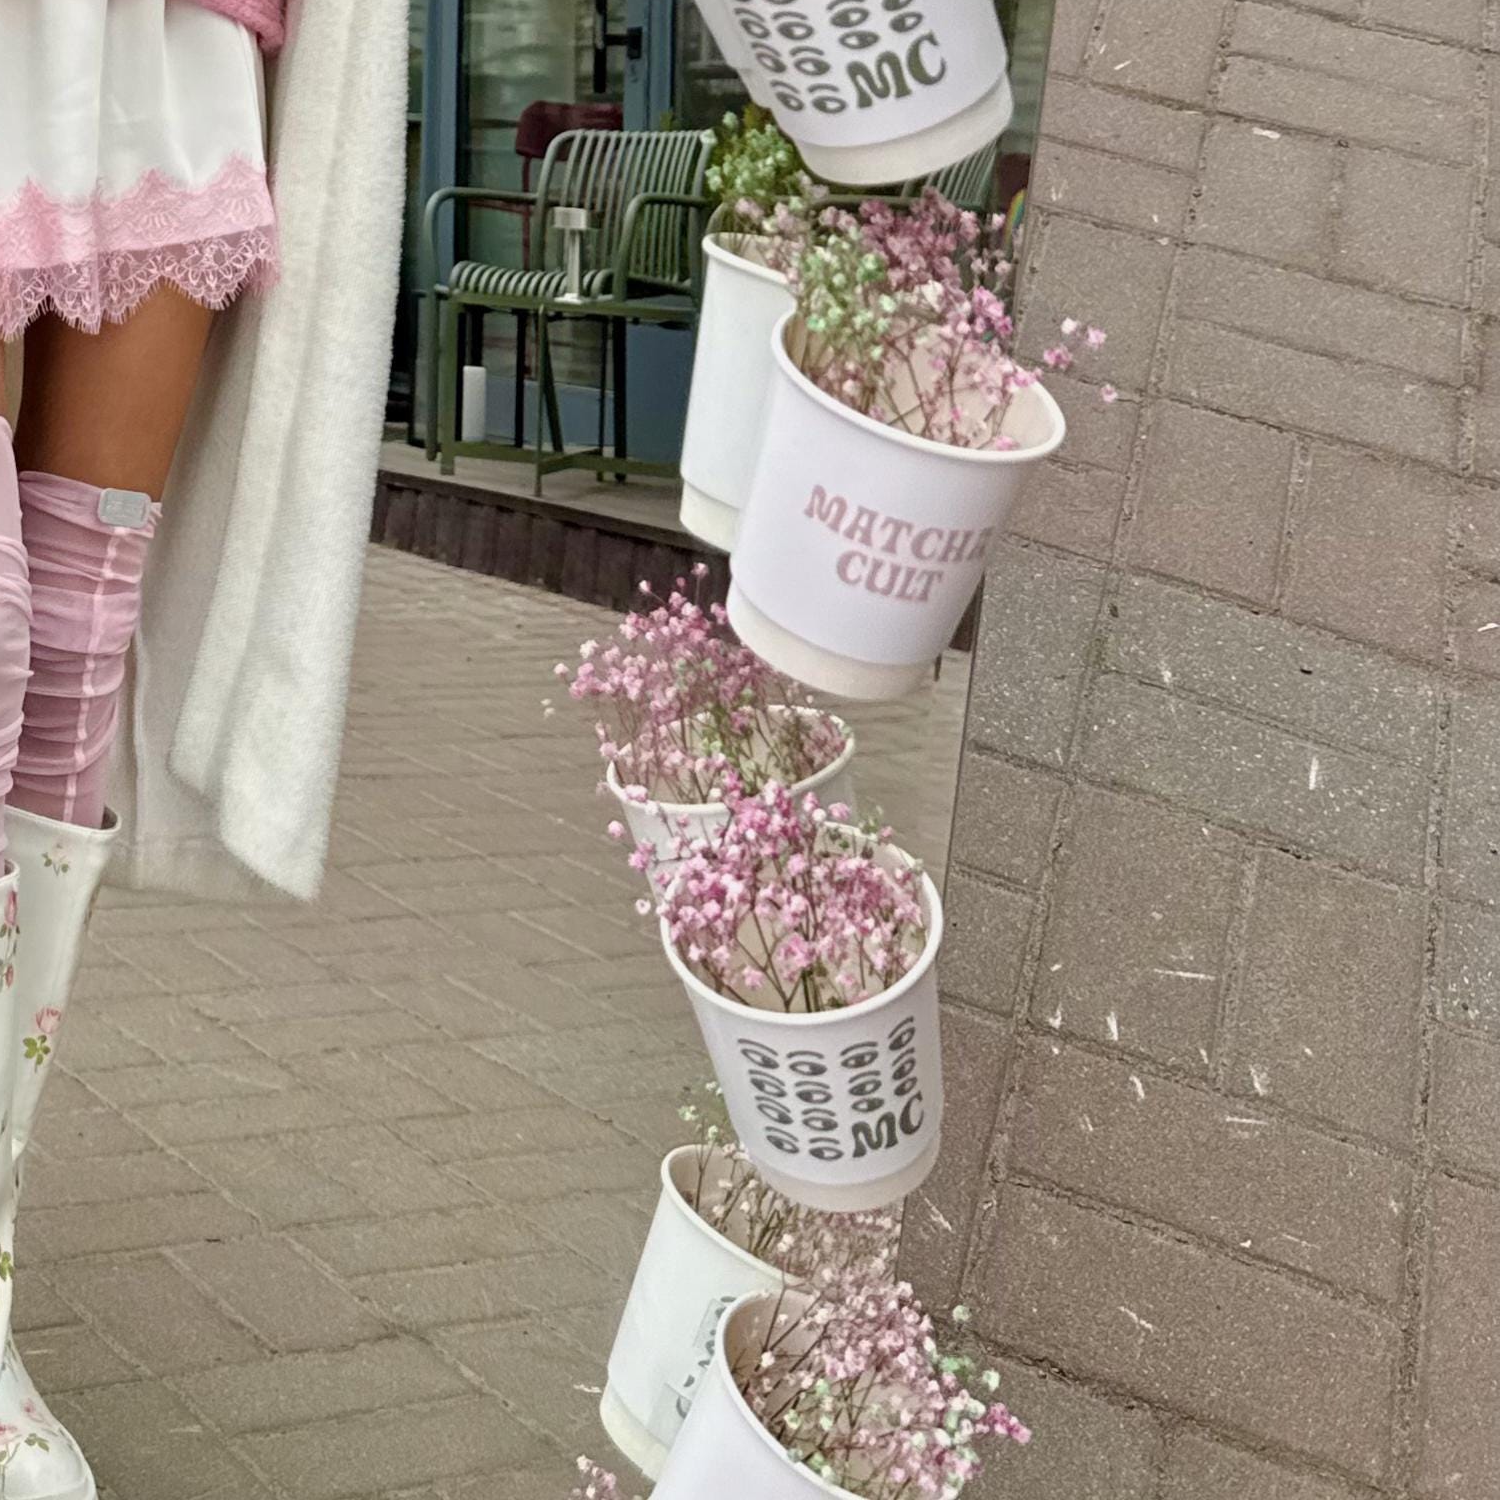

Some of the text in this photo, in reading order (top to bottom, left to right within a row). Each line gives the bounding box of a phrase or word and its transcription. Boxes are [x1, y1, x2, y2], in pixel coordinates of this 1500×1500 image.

[845, 31, 947, 110] MC
[835, 548, 945, 602] CULT
[850, 1094, 925, 1159] MC
